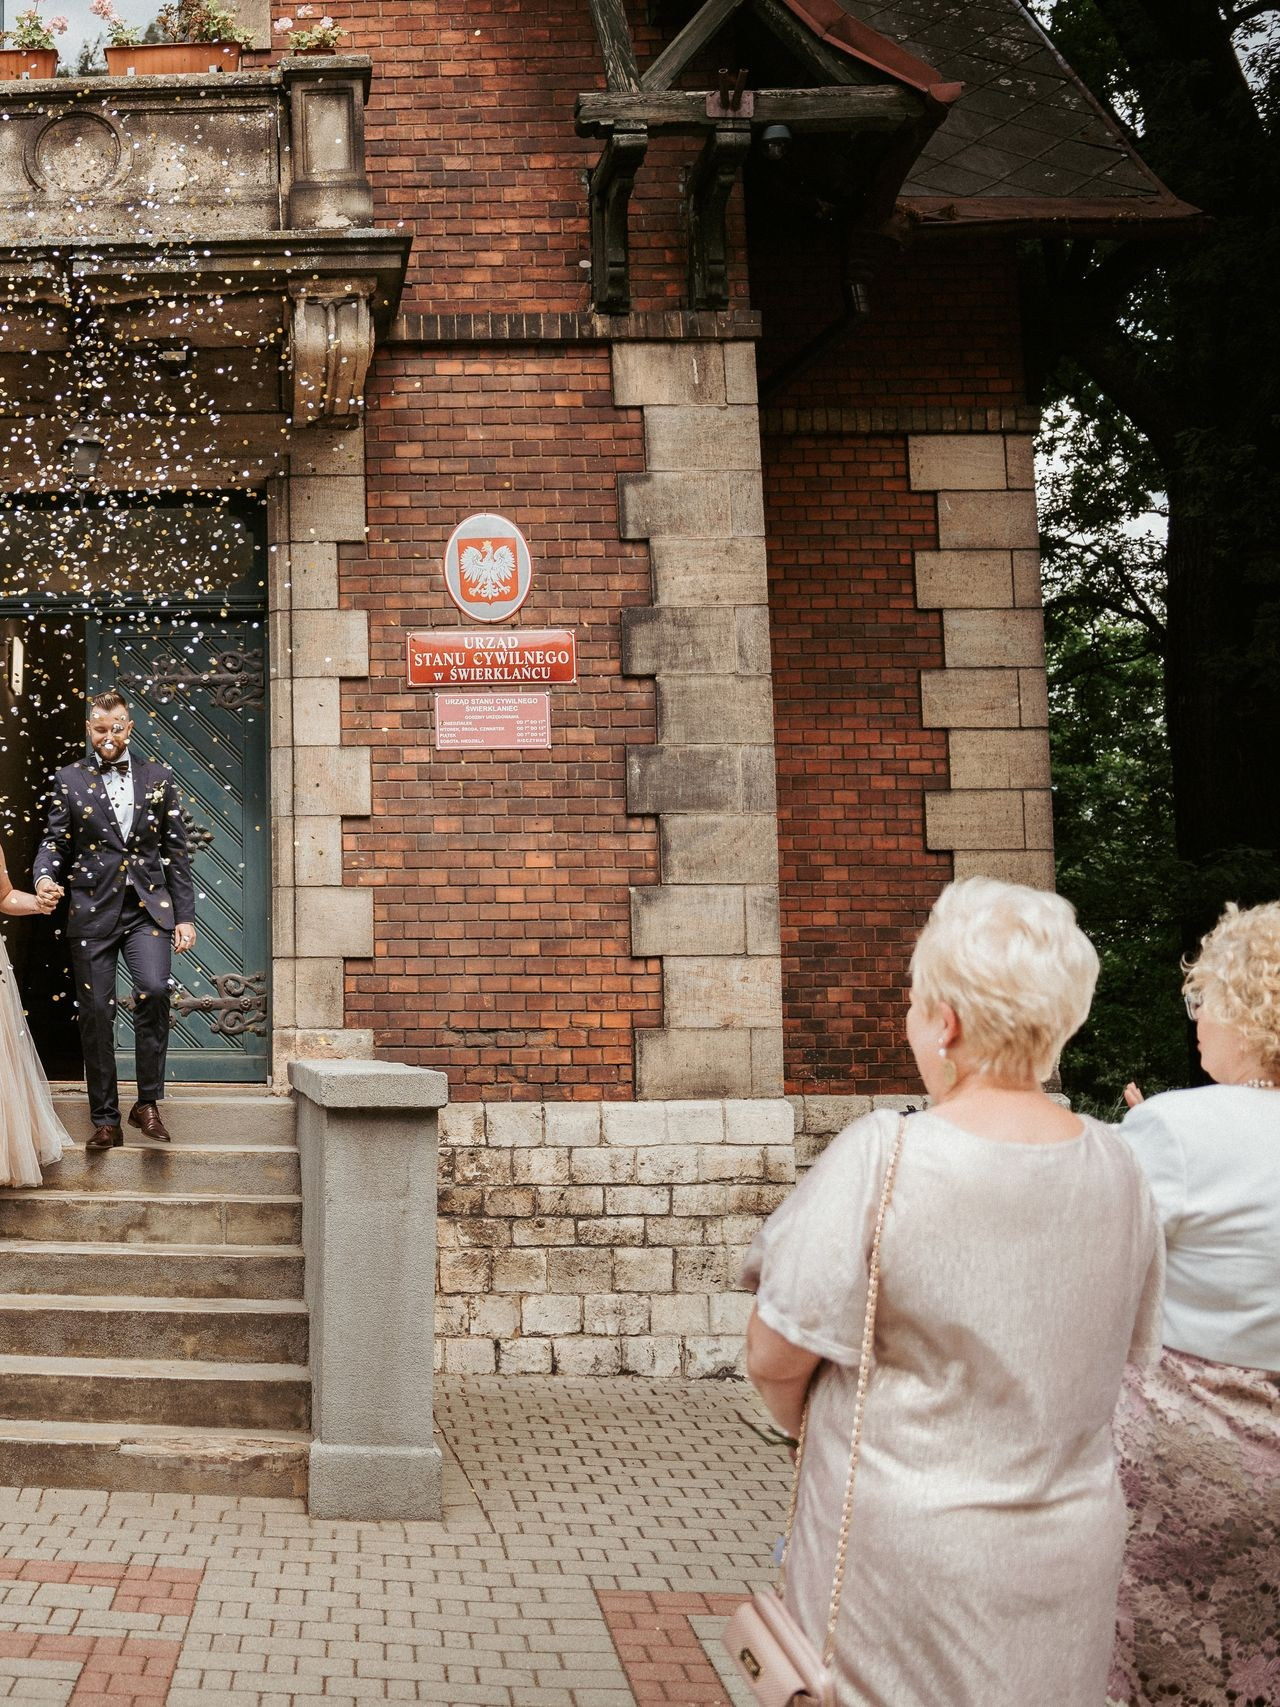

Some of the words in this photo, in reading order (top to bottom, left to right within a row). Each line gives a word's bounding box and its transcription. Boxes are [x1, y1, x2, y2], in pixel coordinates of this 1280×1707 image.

[464, 636, 519, 651] URZĄD
[414, 652, 465, 667] STANU
[473, 650, 570, 665] CYWILNEGO
[433, 672, 444, 681] w
[450, 664, 551, 681] ŚWIERKLAŃCU
[445, 698, 469, 706] URZĄD
